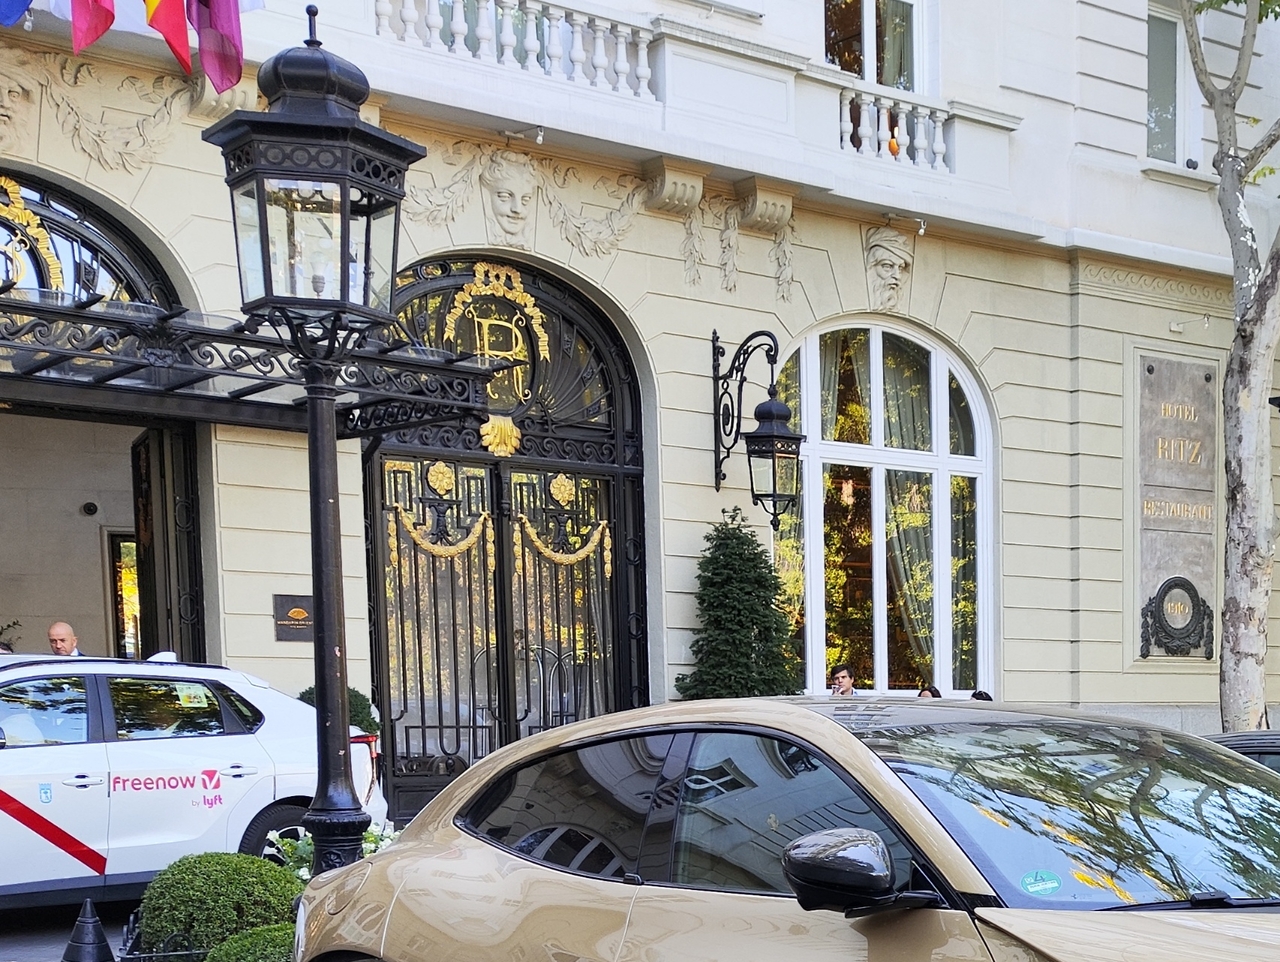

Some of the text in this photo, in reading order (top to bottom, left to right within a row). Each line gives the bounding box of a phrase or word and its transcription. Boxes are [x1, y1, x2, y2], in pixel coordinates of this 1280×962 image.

[1161, 402, 1198, 422] HOTEL
[1157, 436, 1202, 465] RITZ
[1143, 500, 1214, 521] RESTAURANT
[112, 775, 196, 792] freenow
[191, 794, 223, 809] by lyft
